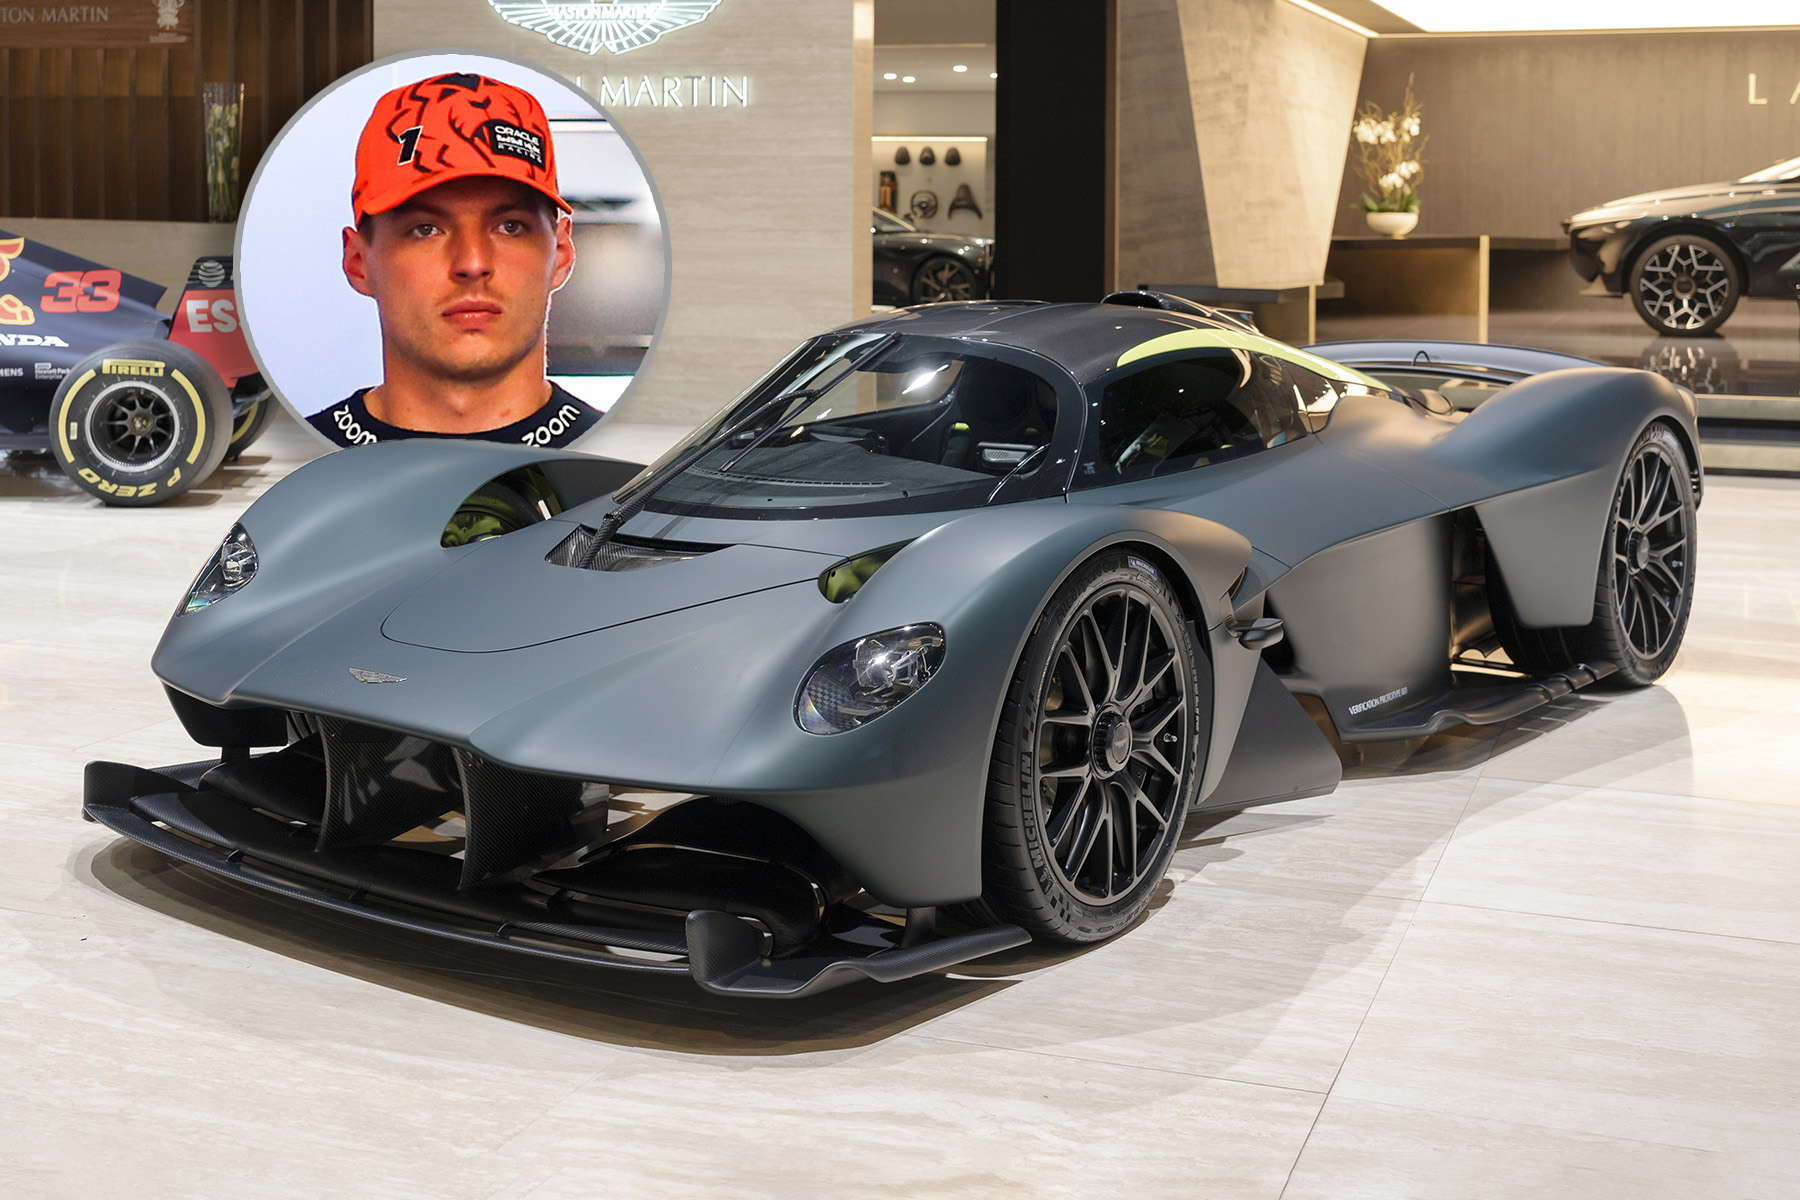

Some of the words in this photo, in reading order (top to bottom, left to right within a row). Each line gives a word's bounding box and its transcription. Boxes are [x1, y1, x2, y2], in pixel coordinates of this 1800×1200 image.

[41, 6, 109, 23] MARTIN
[555, 6, 600, 20] ASTON
[602, 6, 650, 20] MARTIN
[600, 75, 748, 107] MARTIN
[398, 126, 423, 166] 1
[495, 126, 539, 146] ORACLE
[40, 269, 122, 313] 33
[102, 359, 165, 377] PIRELLI
[333, 404, 377, 445] zoom
[521, 404, 580, 448] zoom
[78, 467, 157, 497] ZERO
[167, 467, 181, 487] P
[1135, 560, 1155, 575] MICHELIN
[1021, 752, 1044, 869] MICHELIN
